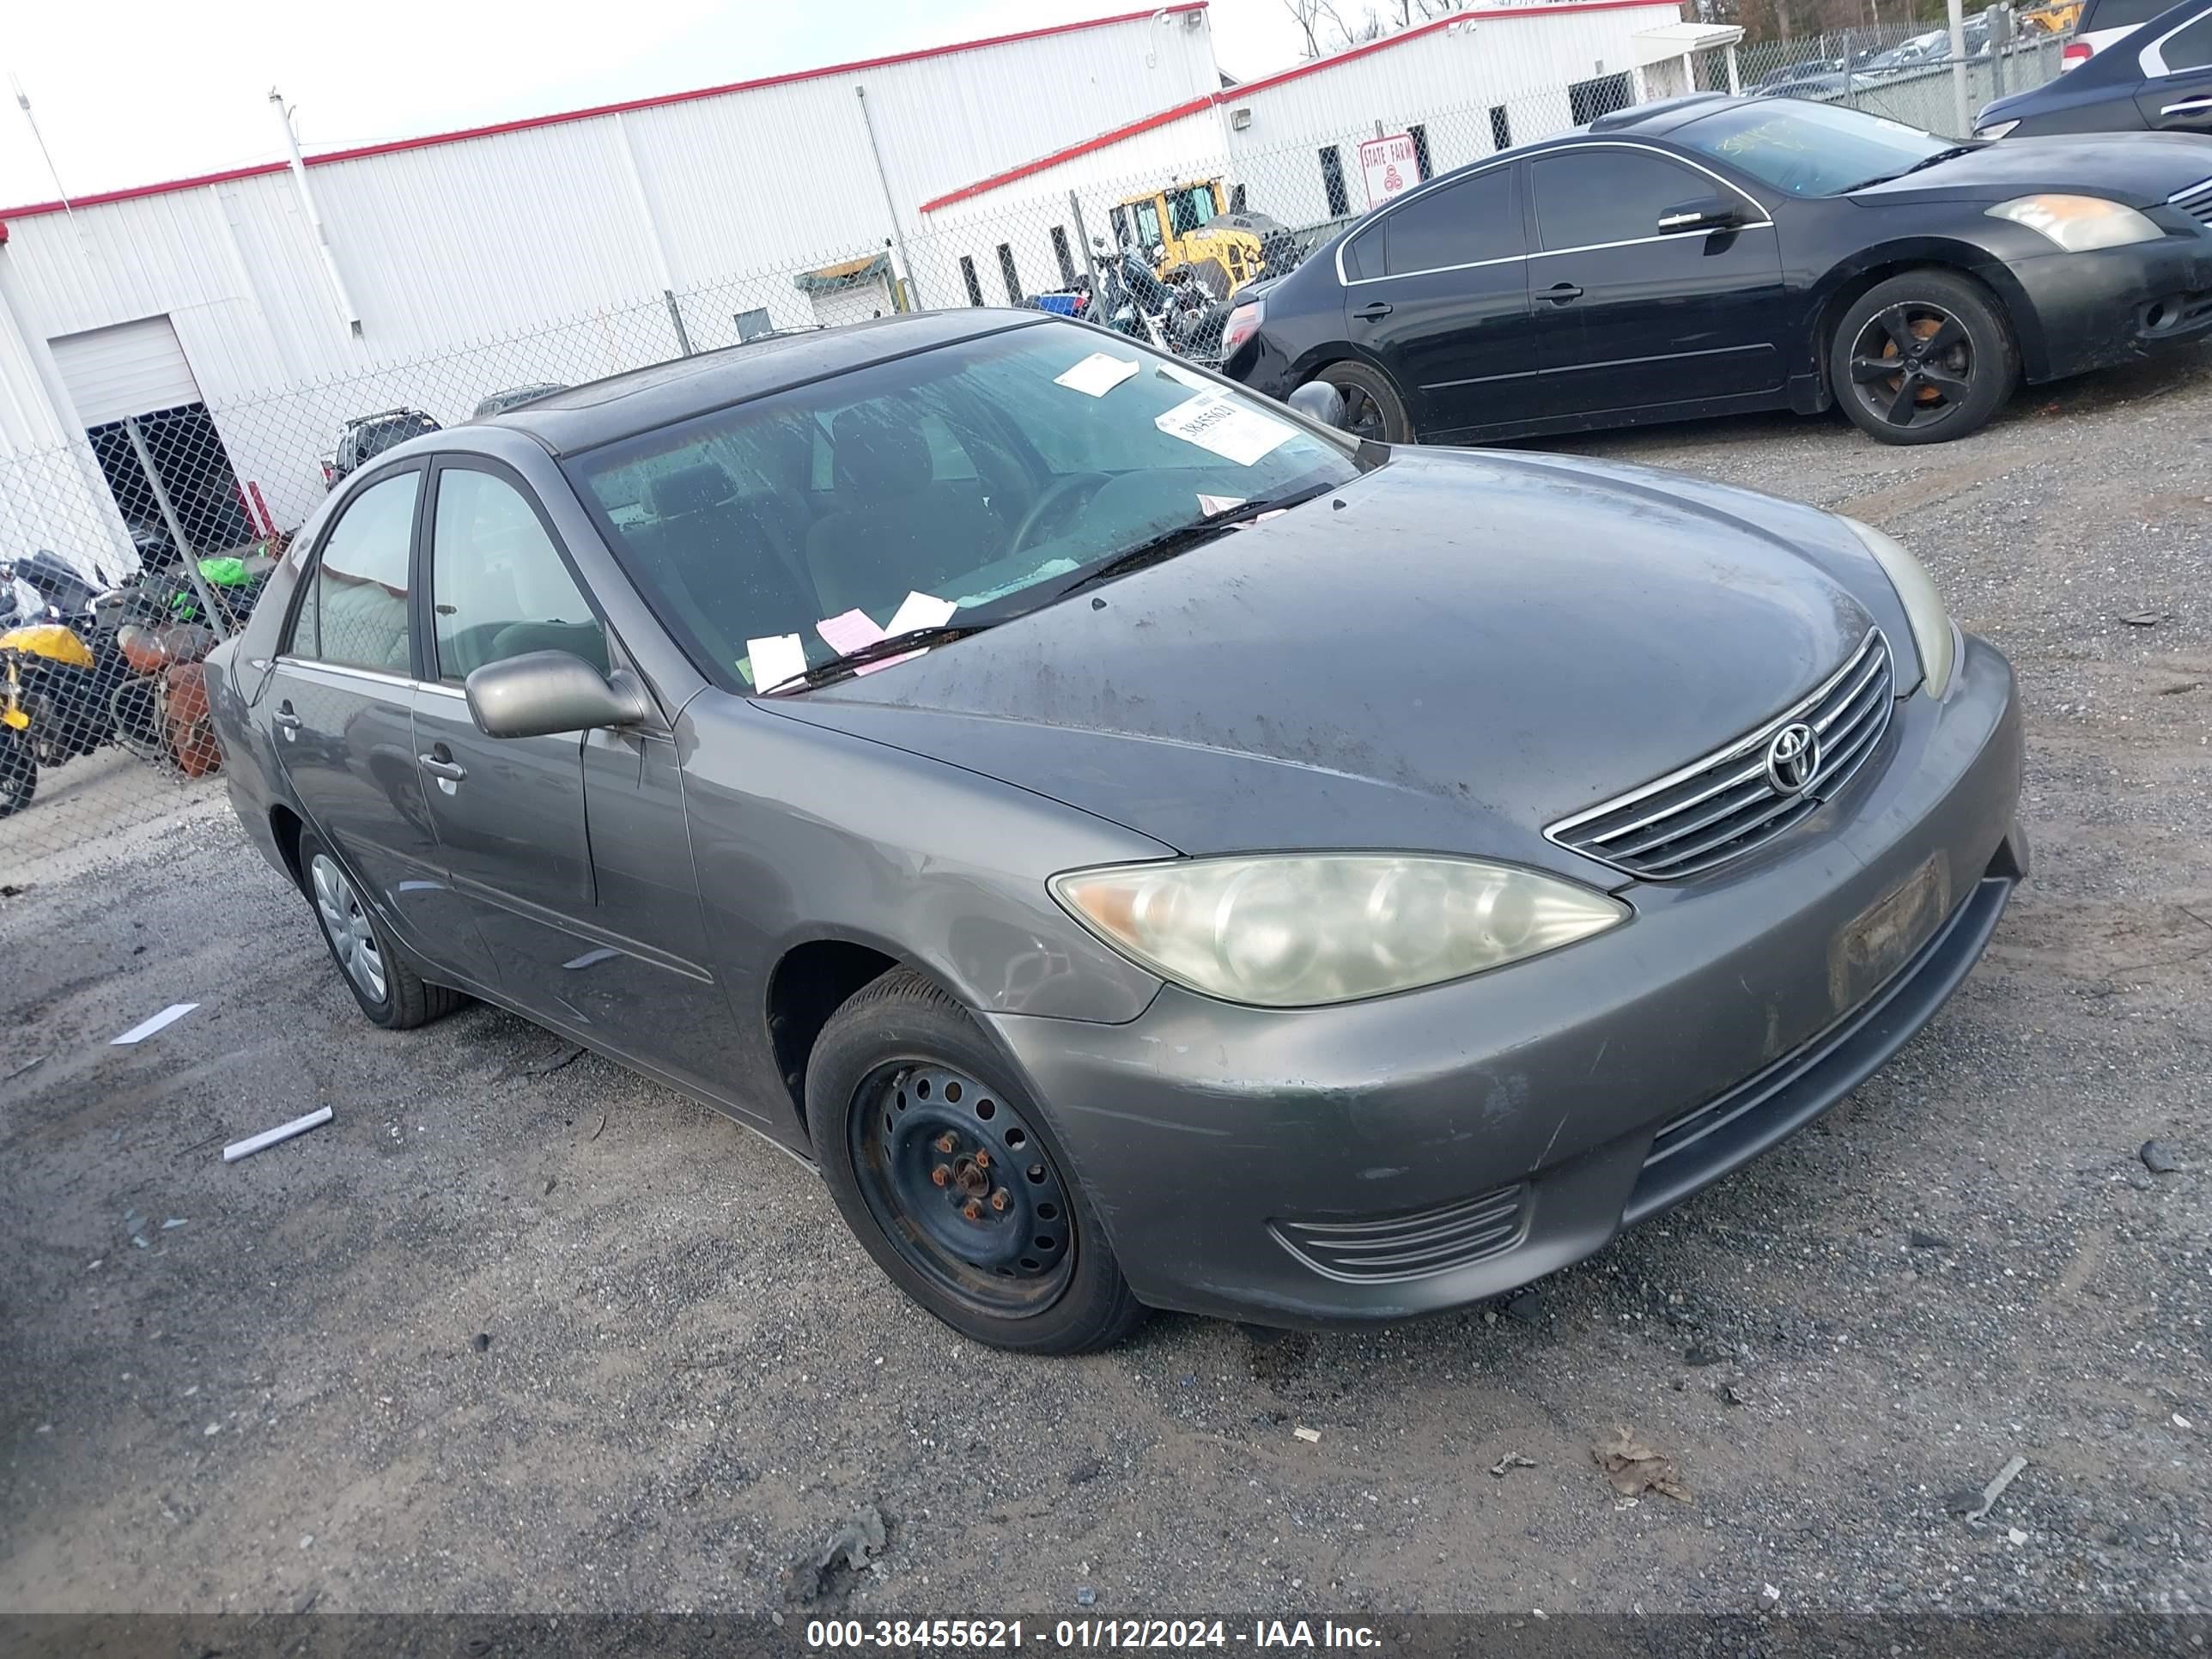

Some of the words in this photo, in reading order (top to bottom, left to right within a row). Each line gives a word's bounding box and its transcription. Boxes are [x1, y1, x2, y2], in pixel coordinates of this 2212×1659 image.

[1364, 146, 1387, 168] STATE
[1389, 140, 1413, 163] FARM
[1179, 404, 1237, 436] 38455621
